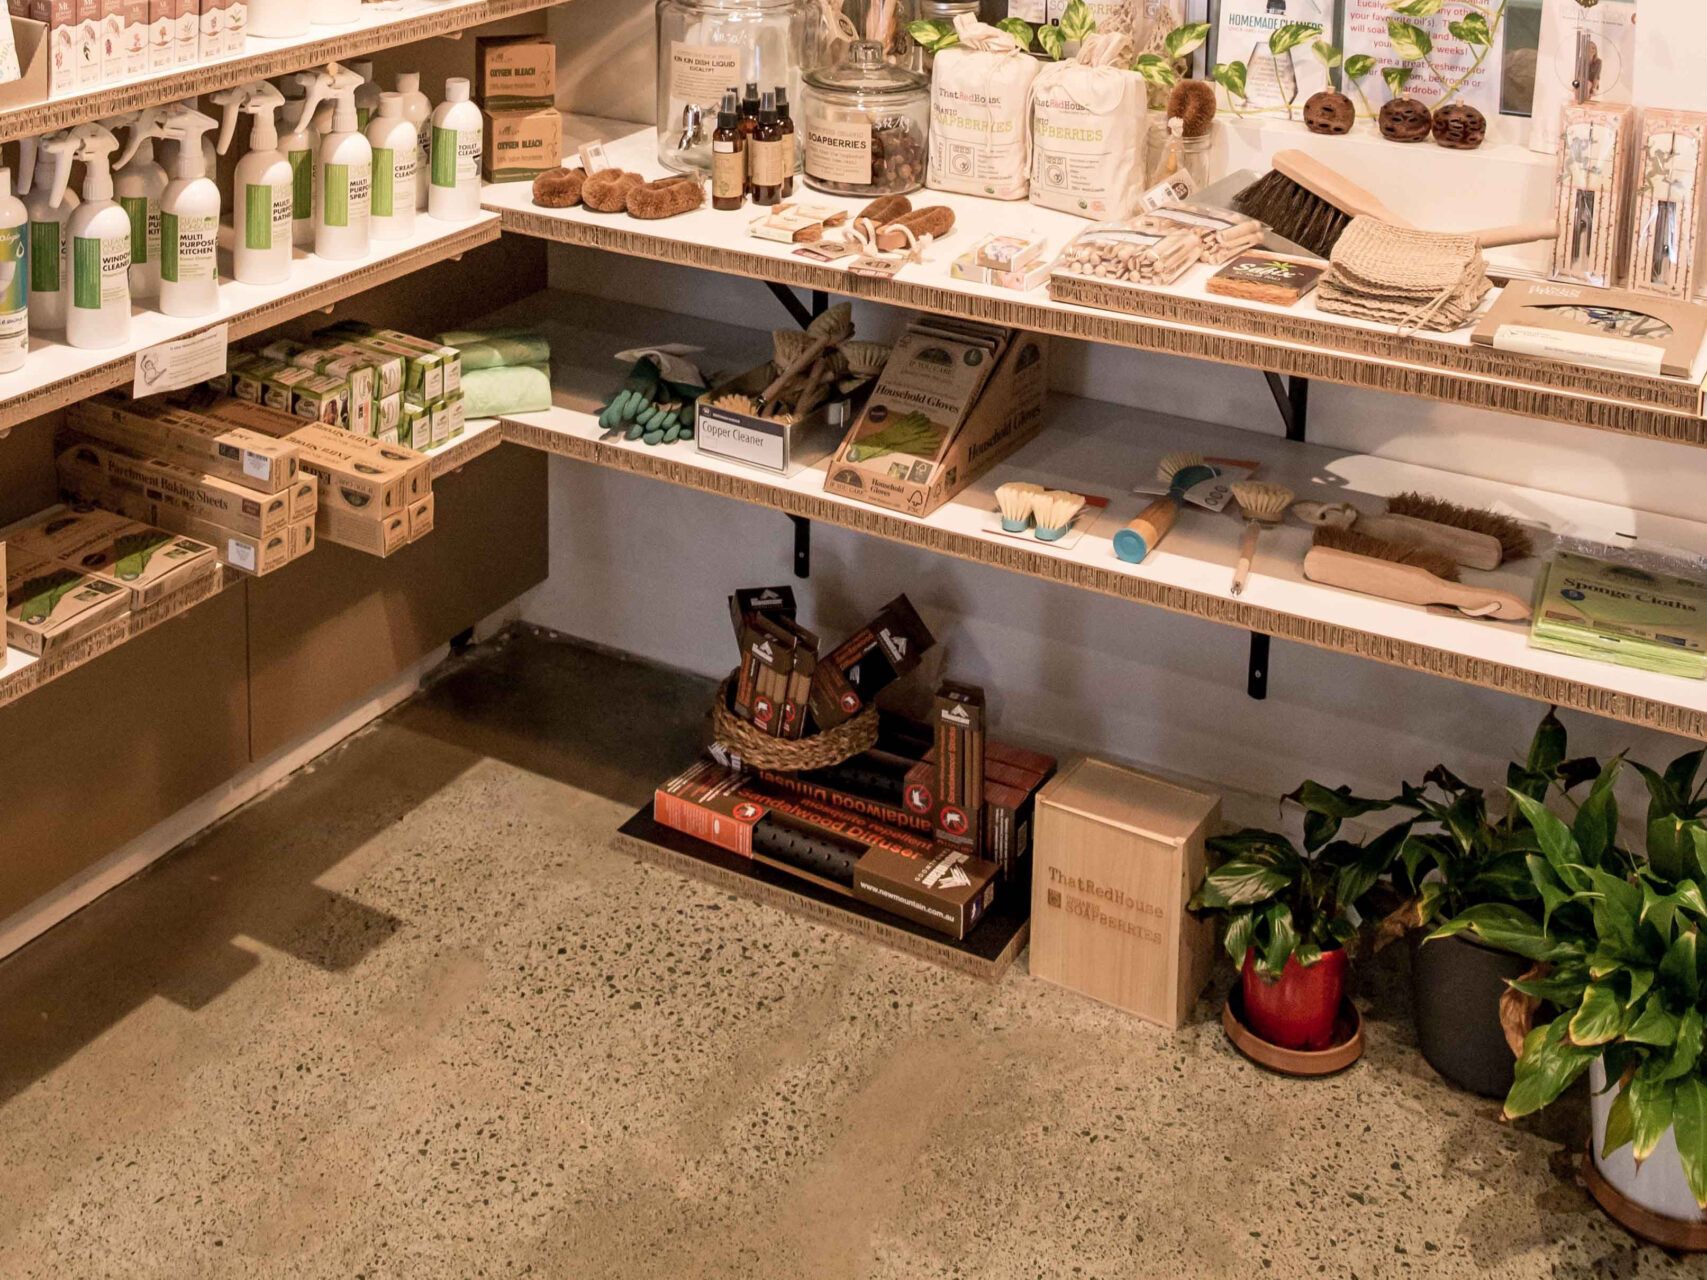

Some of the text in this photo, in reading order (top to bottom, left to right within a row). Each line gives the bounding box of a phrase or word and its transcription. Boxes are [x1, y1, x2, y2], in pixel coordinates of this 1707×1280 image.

[1228, 12, 1280, 30] HOMEMADE
[1350, 10, 1369, 21] your
[1372, 12, 1412, 24] favourite
[1350, 25, 1449, 41] will soak and
[1437, 46, 1468, 56] weeks!
[694, 58, 710, 66] DISH
[711, 60, 736, 68] LIQUID
[1378, 57, 1393, 65] are
[1402, 58, 1425, 68] great
[489, 67, 536, 77] OXYGEN BLEACH
[1402, 84, 1442, 96] ardrobe!
[458, 142, 477, 150] TOILET
[497, 139, 543, 150] OXYGEN BLEACH
[807, 131, 867, 150] SOAPBERRIES
[350, 178, 368, 187] MULTI
[350, 185, 370, 194] PURPO
[349, 192, 368, 200] SPRAY
[273, 199, 290, 208] MULTI
[273, 205, 292, 216] PURPO
[180, 233, 203, 241] MULTI
[179, 239, 214, 248] PURPOSE
[179, 247, 213, 256] KITCHEN
[875, 384, 961, 415] Household Gloves
[702, 420, 764, 448] Copper Cleaner
[108, 460, 229, 511] Parchment Baking Sheets
[871, 477, 905, 495] Household
[870, 486, 891, 498] Gloves
[1563, 577, 1697, 613] Sponge Cloths
[831, 793, 933, 832] andalwood
[799, 797, 933, 851] mosquito repellent
[846, 823, 926, 861] Diffuser
[1048, 865, 1165, 919] ThatRedHouse
[859, 880, 956, 923] www.newmountain.com.au
[1065, 904, 1163, 945] SOAPBERRIES
